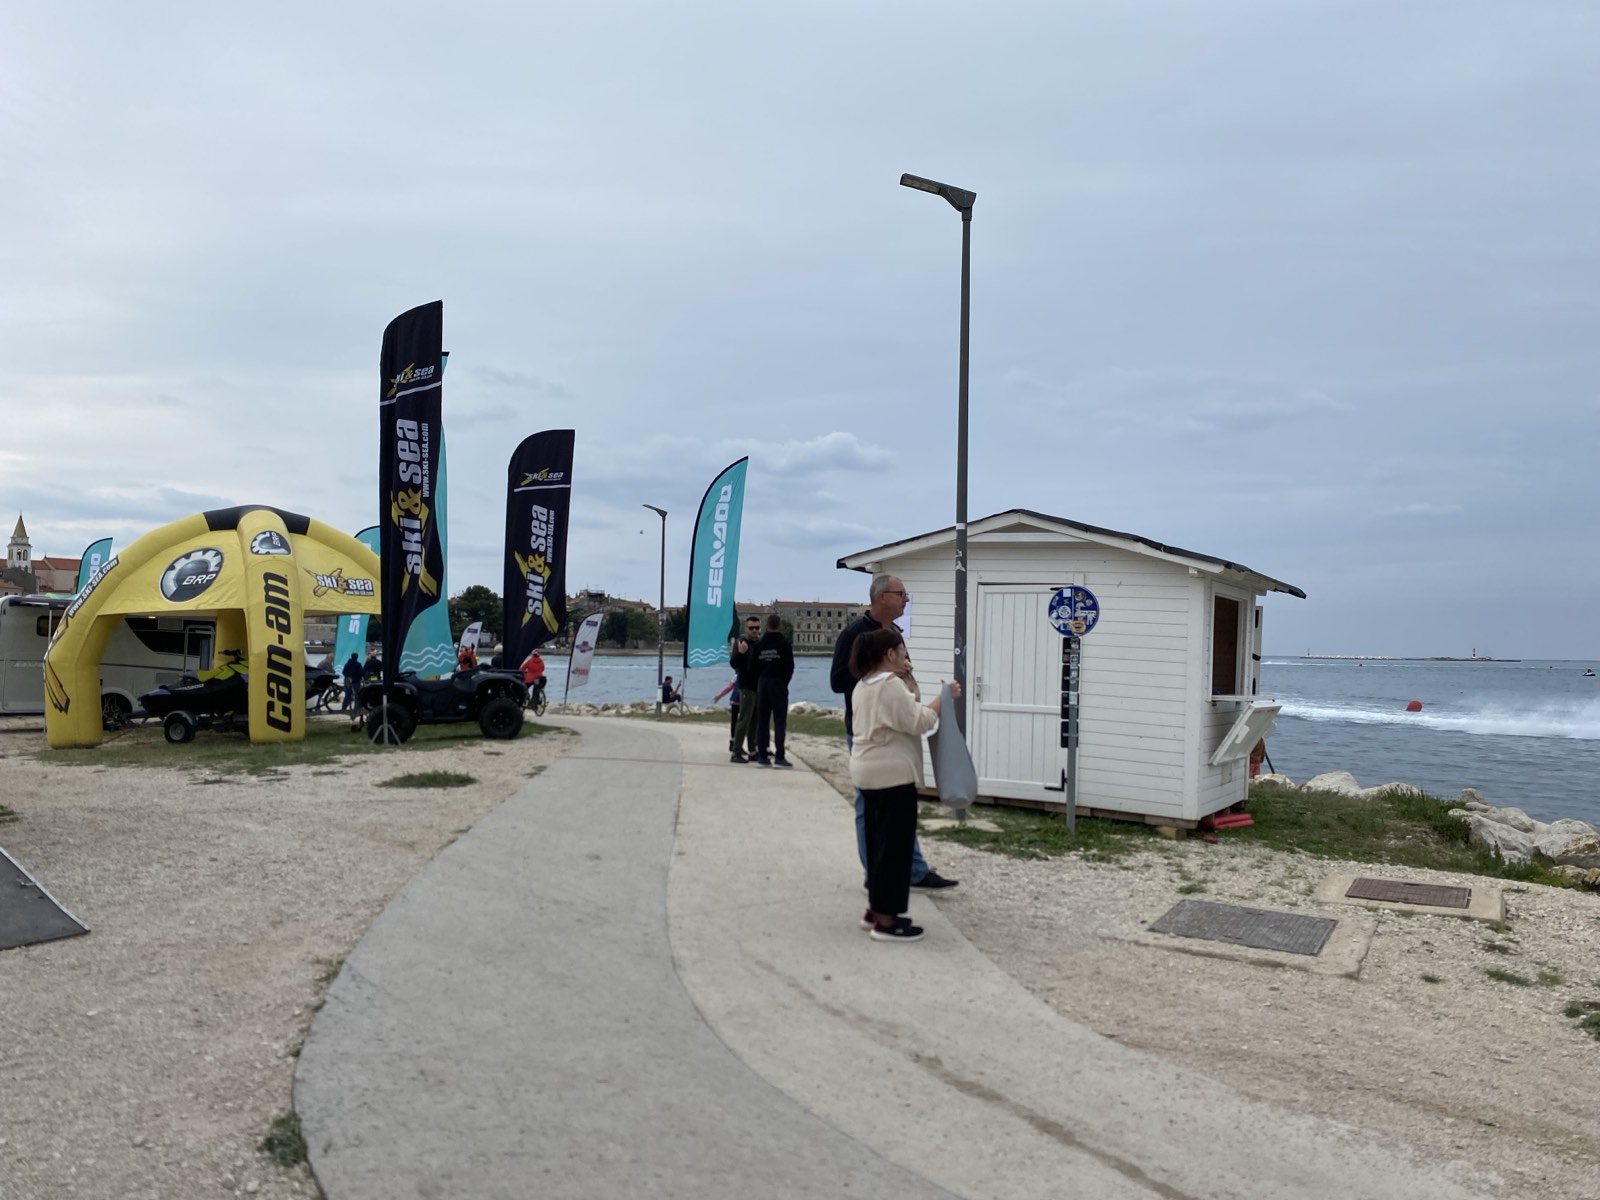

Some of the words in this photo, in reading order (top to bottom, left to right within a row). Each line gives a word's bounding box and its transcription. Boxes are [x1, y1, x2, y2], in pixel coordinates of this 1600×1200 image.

[413, 365, 435, 378] sea
[396, 418, 422, 485] sea
[547, 471, 564, 479] sea
[396, 486, 422, 515] &
[271, 531, 281, 547] BRP
[530, 504, 548, 552] sea
[399, 516, 422, 575] ski
[527, 553, 545, 574] &
[182, 573, 217, 586] BRP
[347, 579, 373, 591] sea
[526, 572, 544, 616] ski
[262, 571, 292, 733] can-am
